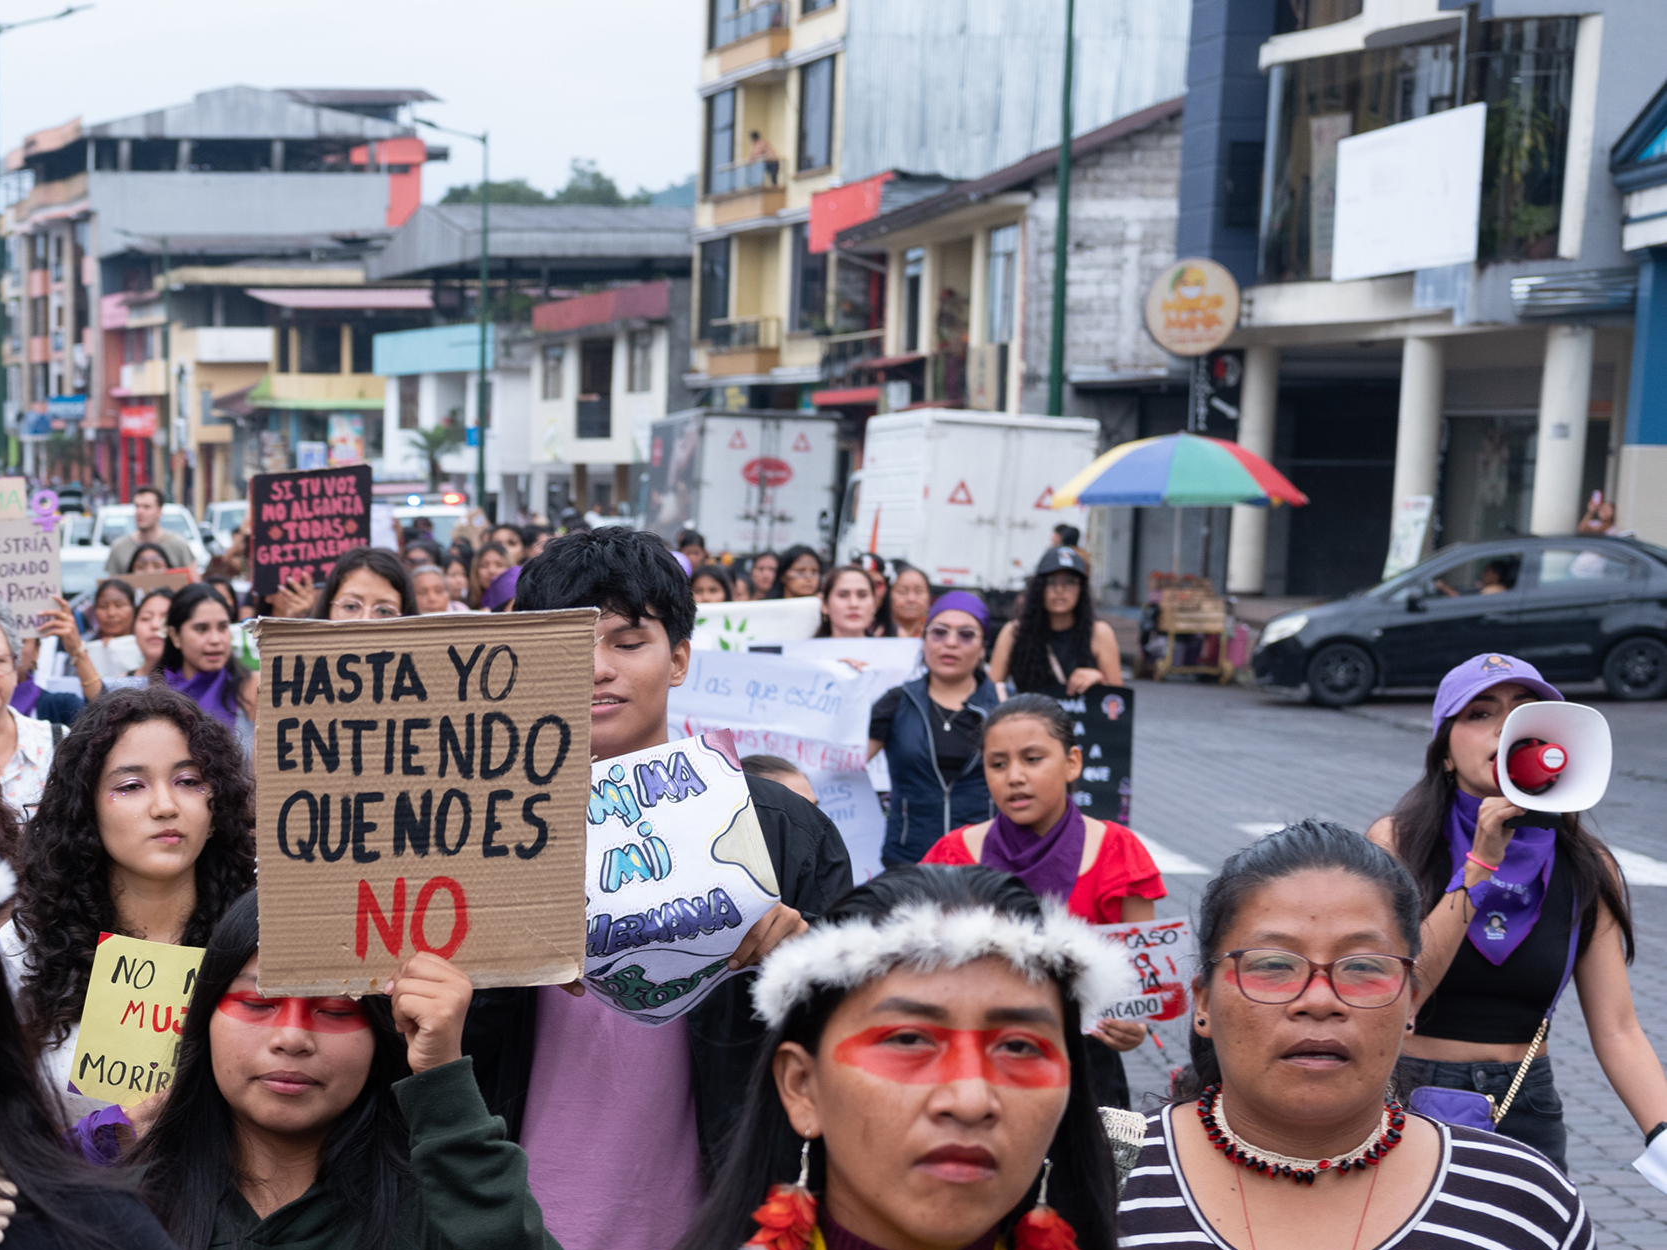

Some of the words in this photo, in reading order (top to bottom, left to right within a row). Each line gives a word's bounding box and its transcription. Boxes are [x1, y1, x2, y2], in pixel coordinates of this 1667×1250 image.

[261, 502, 287, 522] NO
[290, 495, 365, 521] ALCANZA
[270, 480, 295, 501] SI
[298, 478, 321, 498] TU
[323, 475, 357, 497] VOZ
[282, 518, 345, 542] TODAS
[7, 581, 57, 602] PATÁN
[271, 650, 428, 707] HASTA
[447, 644, 519, 701] YO
[692, 657, 732, 697] las
[745, 678, 778, 714] que
[785, 672, 843, 716] están
[277, 712, 572, 786] ENTIENDO
[277, 790, 385, 863] QUE
[393, 789, 472, 858] NO
[482, 789, 557, 859] ES
[355, 876, 471, 962] NO
[586, 887, 742, 957] HERMANA
[111, 955, 155, 990] NO
